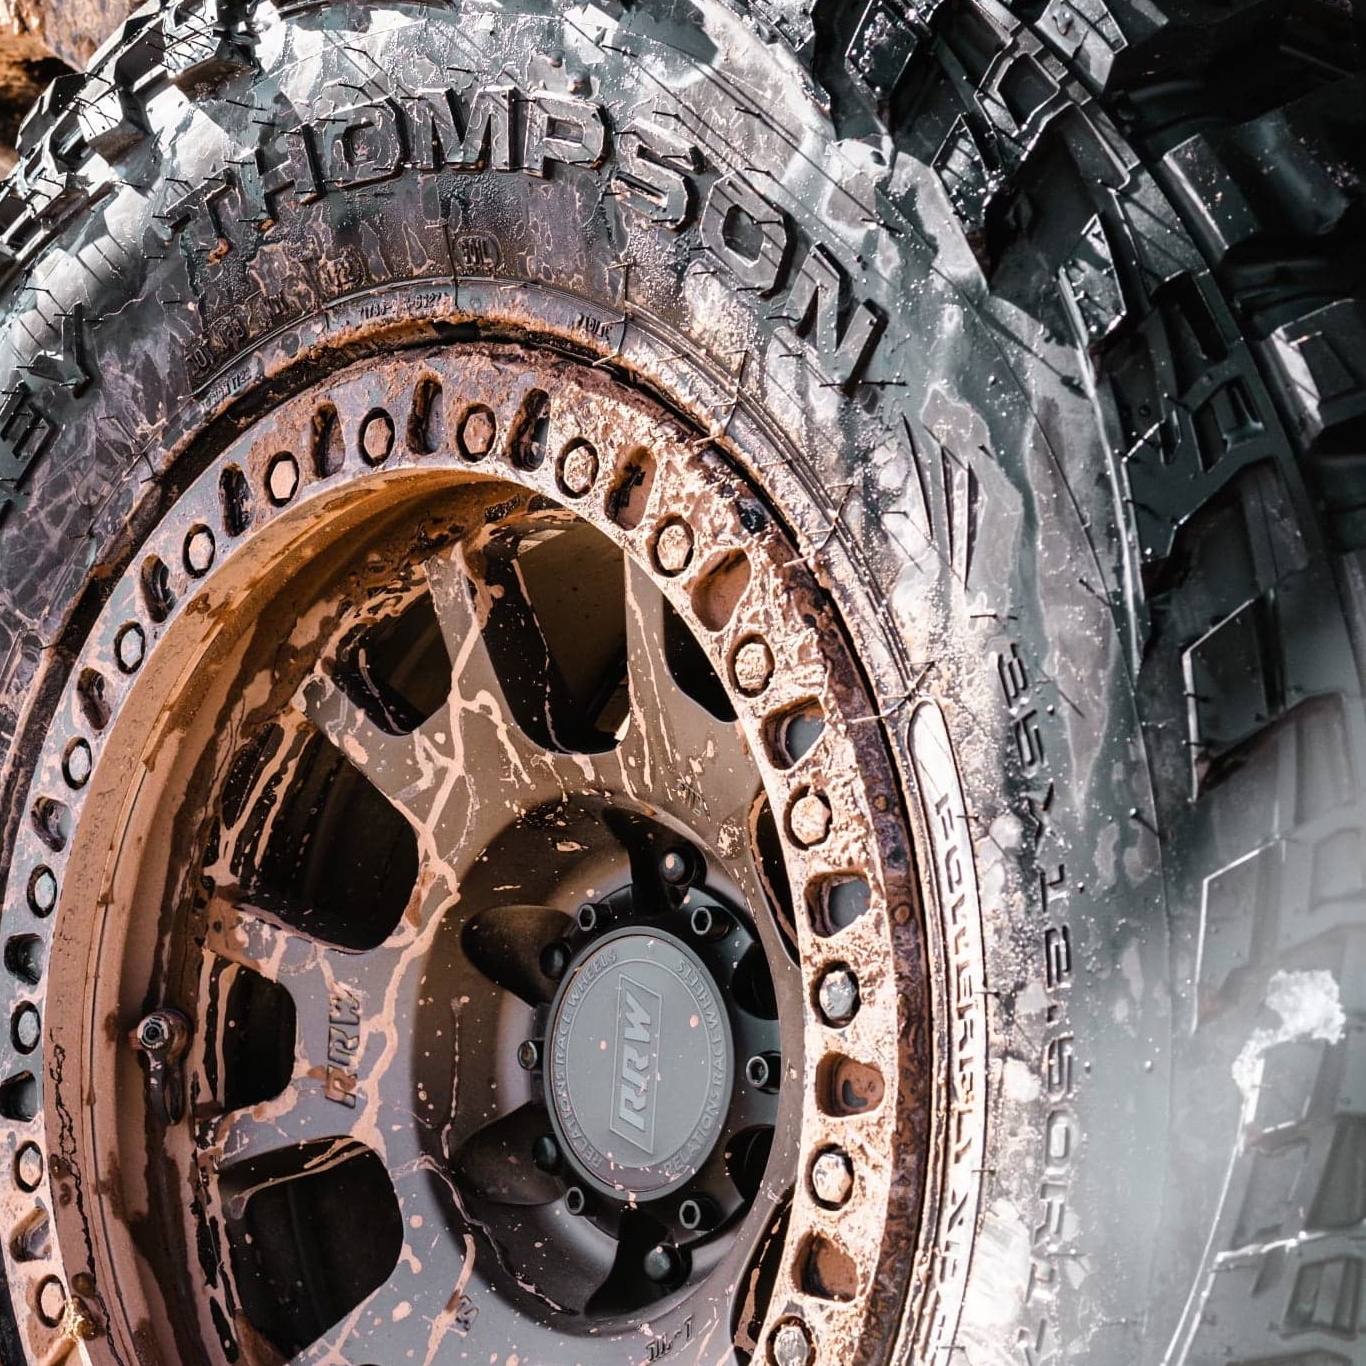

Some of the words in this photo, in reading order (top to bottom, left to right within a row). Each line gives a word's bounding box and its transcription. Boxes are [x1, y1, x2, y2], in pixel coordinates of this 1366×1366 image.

[164, 85, 890, 397] THOMPSON
[567, 949, 618, 1005] WHEELS
[676, 958, 719, 1030] WHEELS
[325, 988, 360, 1110] RRW
[554, 1014, 571, 1066] RACE
[618, 990, 651, 1132] RRW
[710, 1037, 724, 1087] RACE
[555, 1071, 602, 1169] RELATIONS
[662, 1091, 722, 1175] RELATIONS
